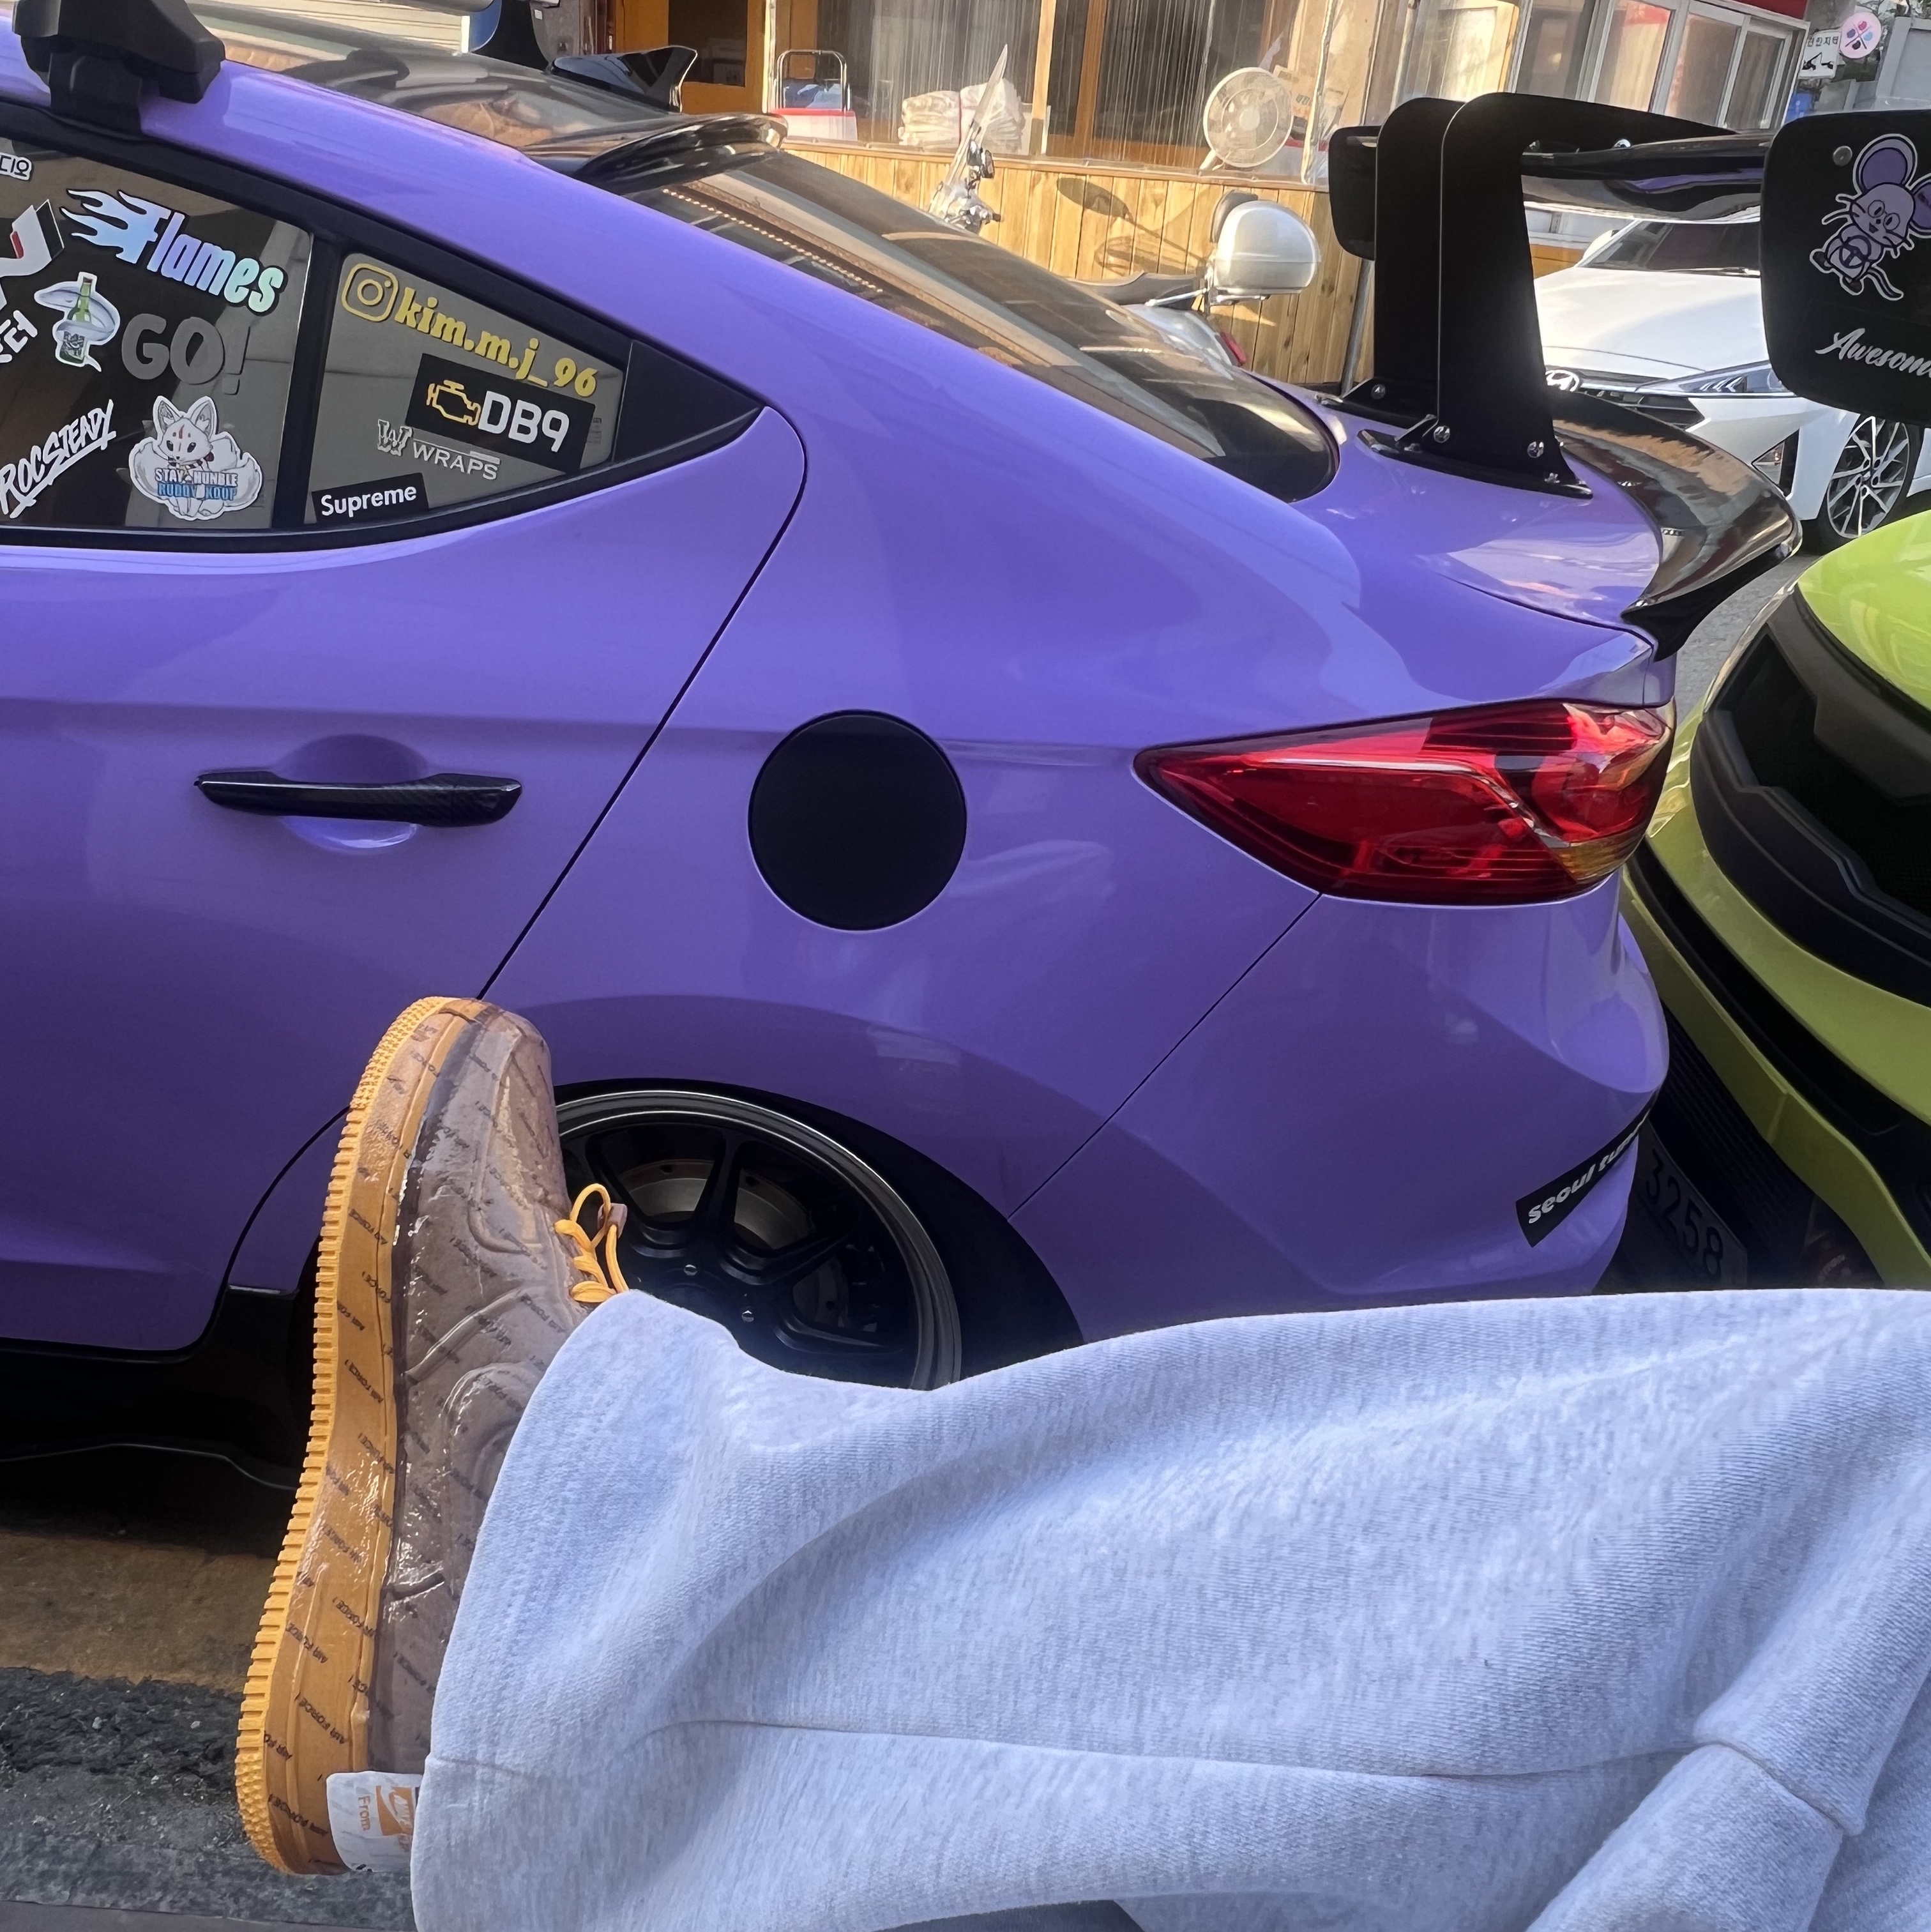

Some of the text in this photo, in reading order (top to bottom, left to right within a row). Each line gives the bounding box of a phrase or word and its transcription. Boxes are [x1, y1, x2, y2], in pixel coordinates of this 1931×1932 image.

[61, 189, 285, 312] Flames
[121, 313, 251, 395] GO!
[394, 287, 600, 397] kim.m.j_96
[1815, 328, 1931, 378] Awesom
[478, 390, 570, 453] DB9
[413, 441, 498, 480] WRAPS
[321, 485, 417, 517] Supreme
[1528, 1164, 1596, 1224] seoul
[1646, 1148, 1723, 1282] 3258
[298, 1698, 331, 1730] FORCE
[358, 1795, 371, 1831] From
